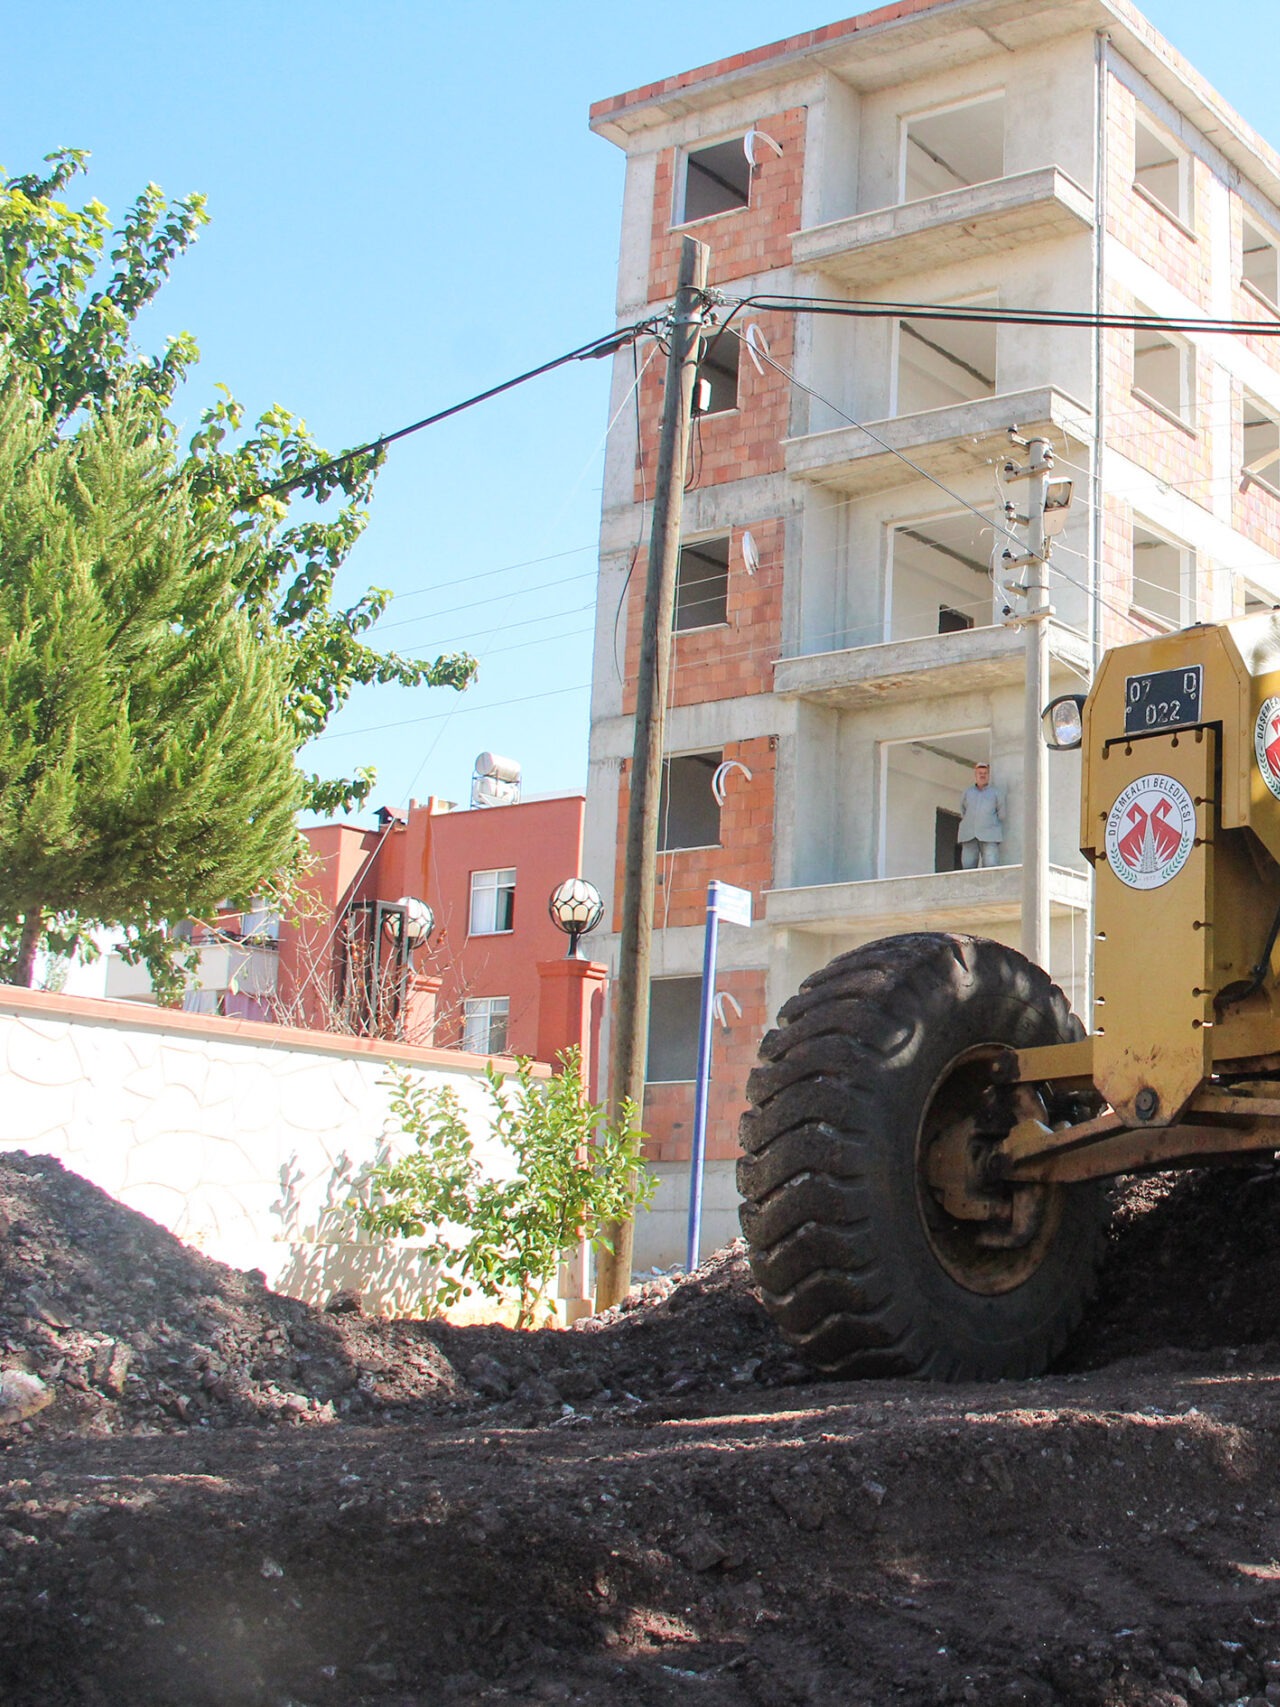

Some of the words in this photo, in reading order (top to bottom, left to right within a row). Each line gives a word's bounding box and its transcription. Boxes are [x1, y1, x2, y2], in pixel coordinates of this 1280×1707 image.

[1130, 679, 1152, 702] 07
[1183, 672, 1197, 694] D
[1145, 699, 1181, 725] 022
